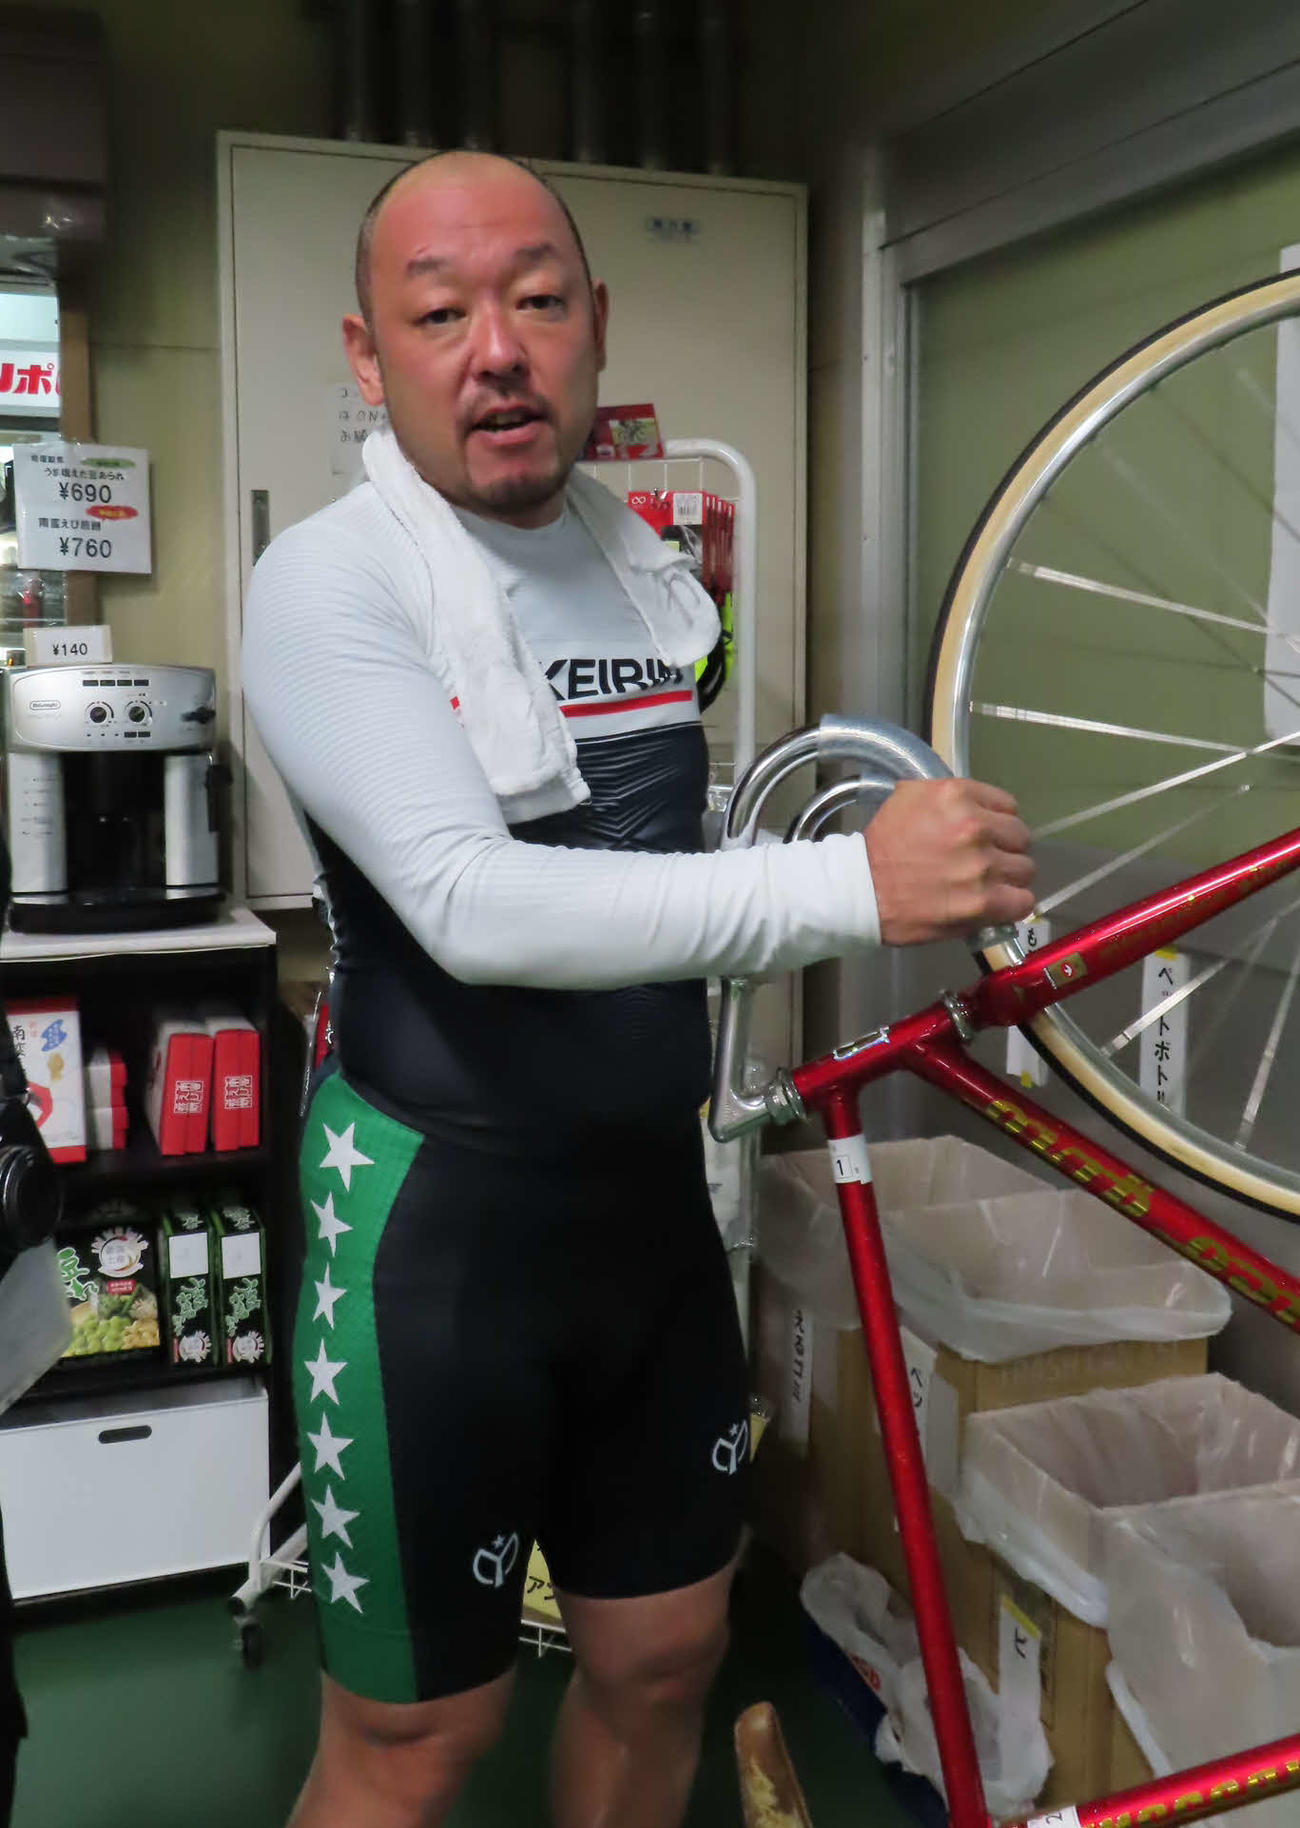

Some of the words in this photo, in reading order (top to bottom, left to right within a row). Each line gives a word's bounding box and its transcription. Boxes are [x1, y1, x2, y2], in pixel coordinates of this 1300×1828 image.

[0, 362, 60, 396] リポ
[59, 482, 112, 503] ¥690
[59, 536, 112, 558] ¥760
[52, 642, 88, 656] ¥140
[836, 1159, 844, 1176] 1
